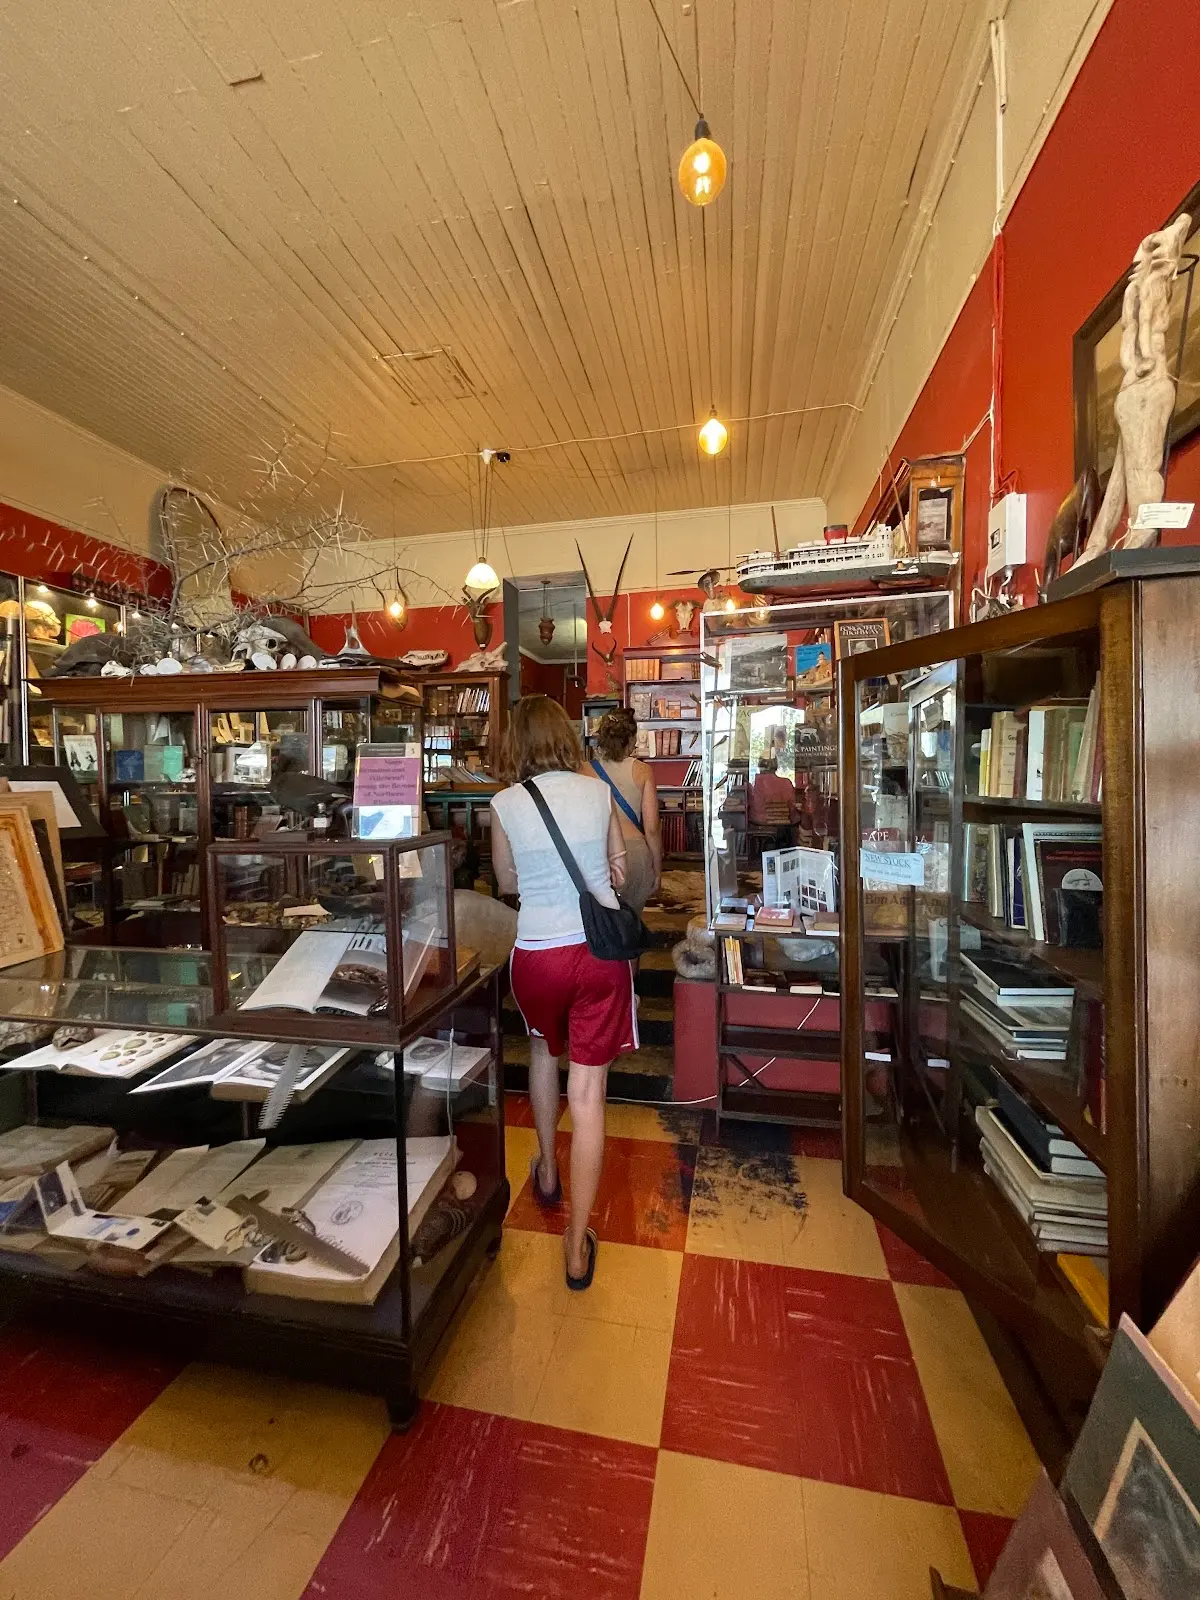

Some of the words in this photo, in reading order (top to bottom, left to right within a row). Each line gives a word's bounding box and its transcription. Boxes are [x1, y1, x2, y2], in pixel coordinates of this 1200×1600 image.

[840, 624, 883, 632] FORGOTTEN
[862, 831, 889, 841] APE
[865, 853, 882, 863] NEW
[884, 856, 911, 868] STOCK
